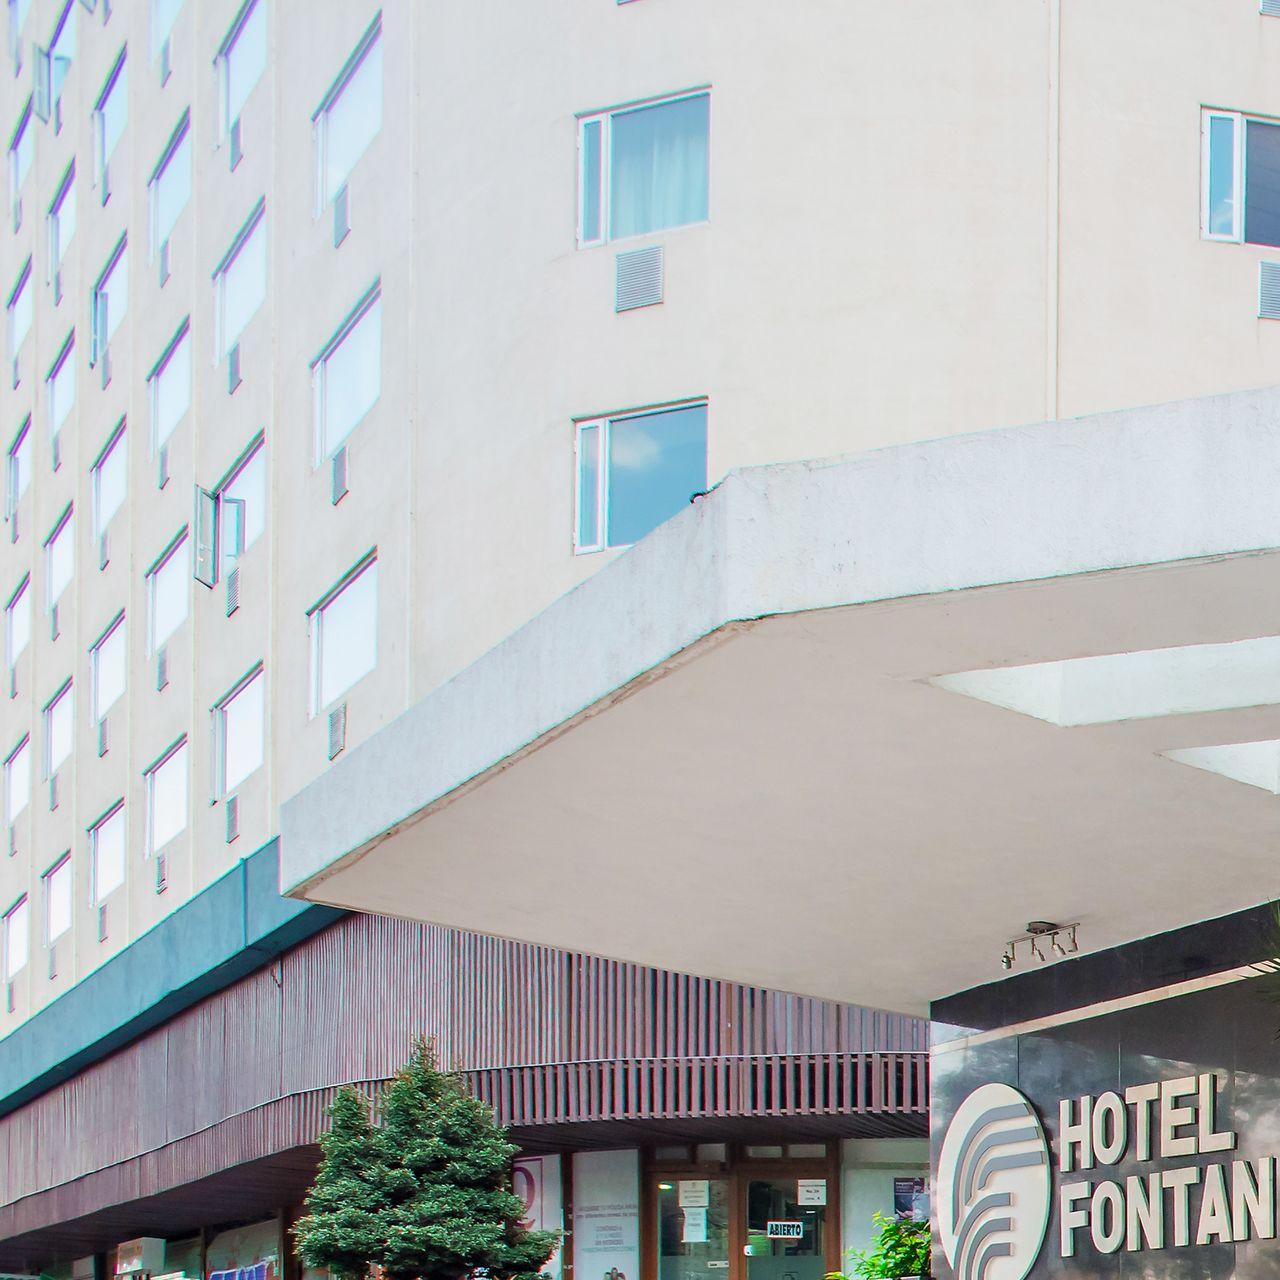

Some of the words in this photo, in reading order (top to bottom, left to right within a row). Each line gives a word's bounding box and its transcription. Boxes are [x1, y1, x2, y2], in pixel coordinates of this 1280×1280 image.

[1059, 1073, 1237, 1172] HOTEL
[769, 1223, 802, 1237] ABIERTO
[1060, 1155, 1277, 1258] FONTAN
